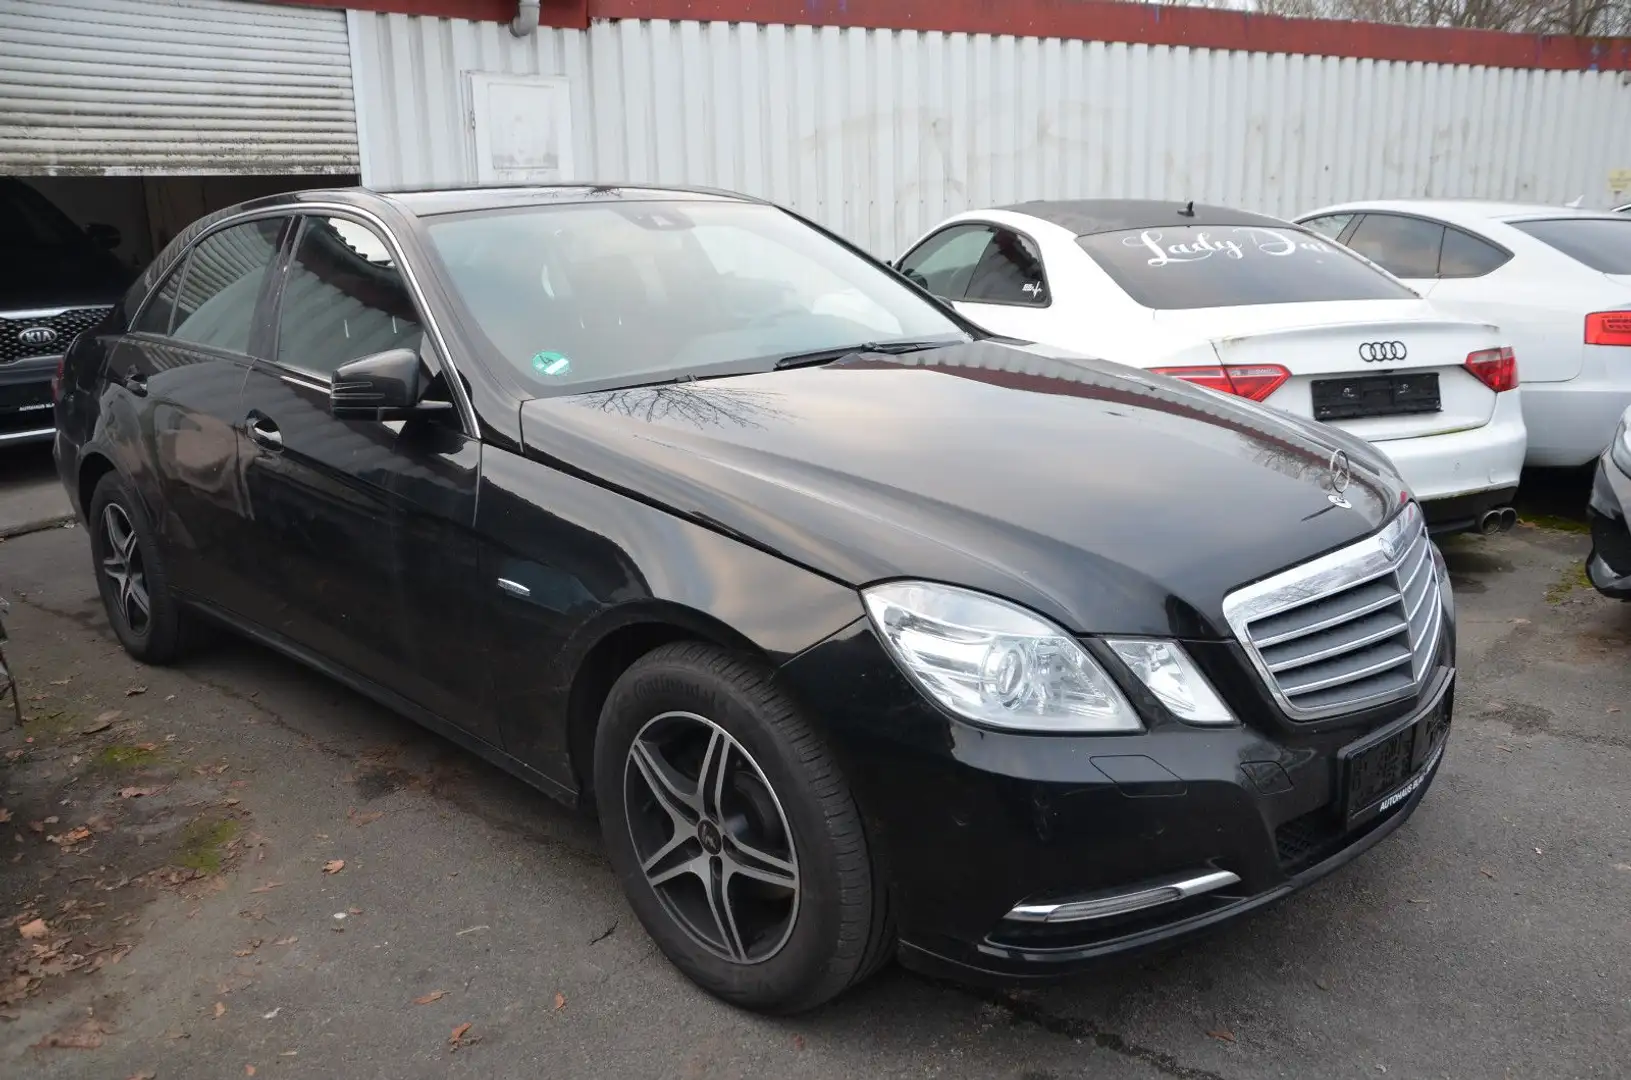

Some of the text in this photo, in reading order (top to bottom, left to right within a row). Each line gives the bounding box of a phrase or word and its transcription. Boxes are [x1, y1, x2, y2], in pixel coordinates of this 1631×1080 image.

[1122, 230, 1243, 267] Lady
[25, 330, 52, 342] KIA
[1379, 783, 1413, 812] AUTOHAUS
